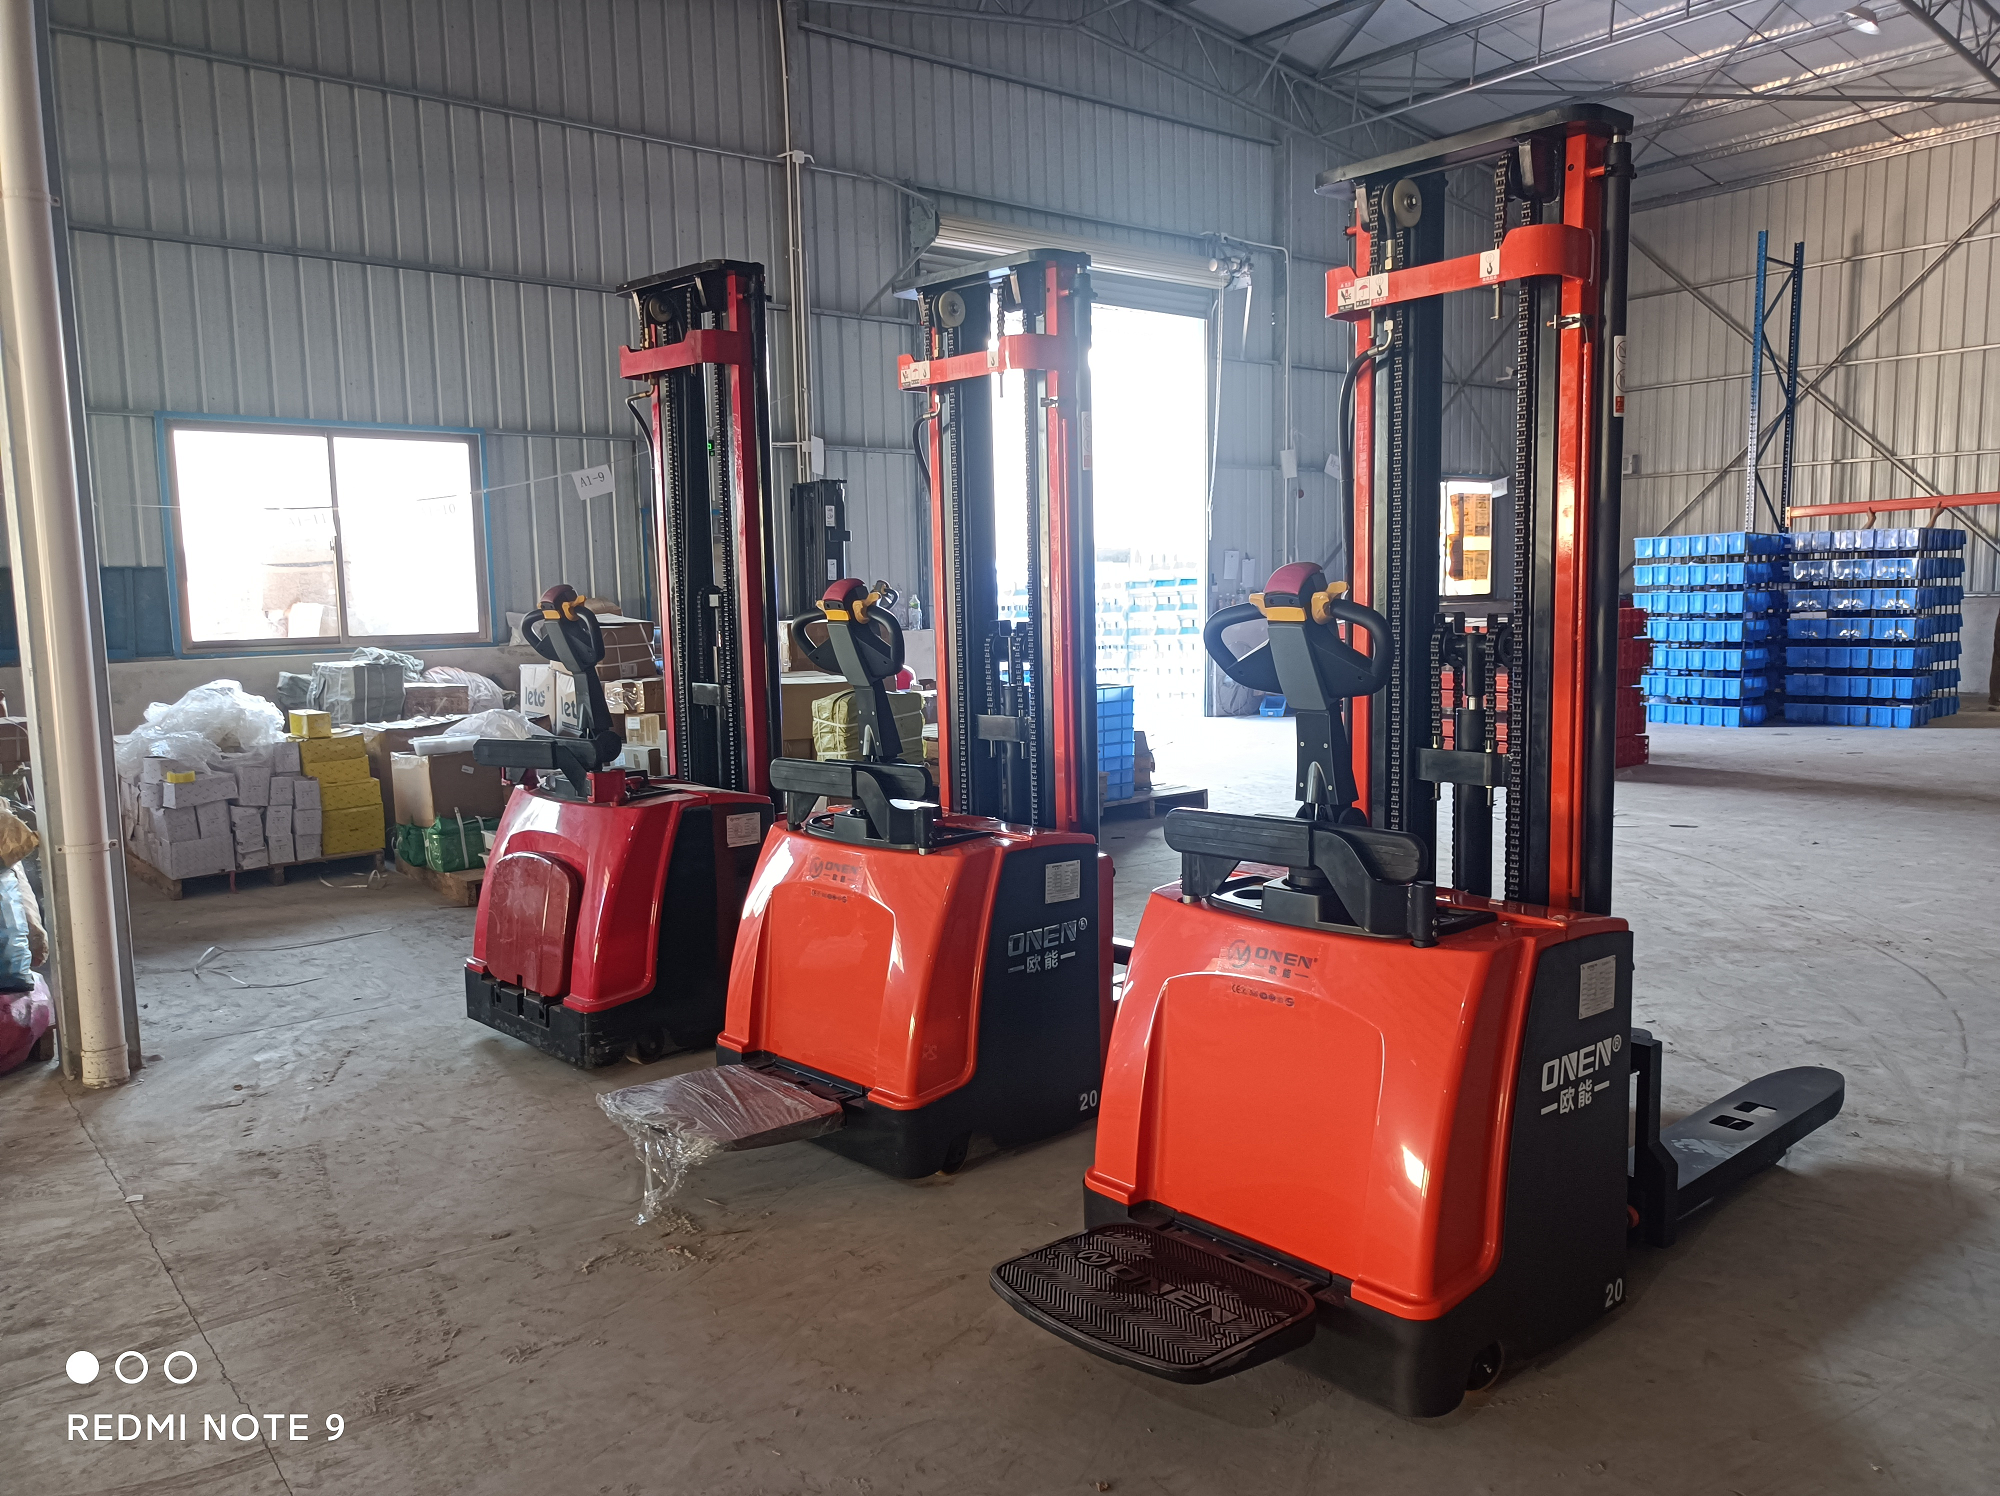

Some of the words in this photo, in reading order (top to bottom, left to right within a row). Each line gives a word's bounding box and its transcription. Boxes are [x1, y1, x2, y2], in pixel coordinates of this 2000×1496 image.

[580, 471, 605, 488] A1-9
[1026, 949, 1059, 974] 欧能
[1080, 1089, 1098, 1111] 20
[1559, 1079, 1593, 1115] 欧能
[1605, 1277, 1623, 1308] 20
